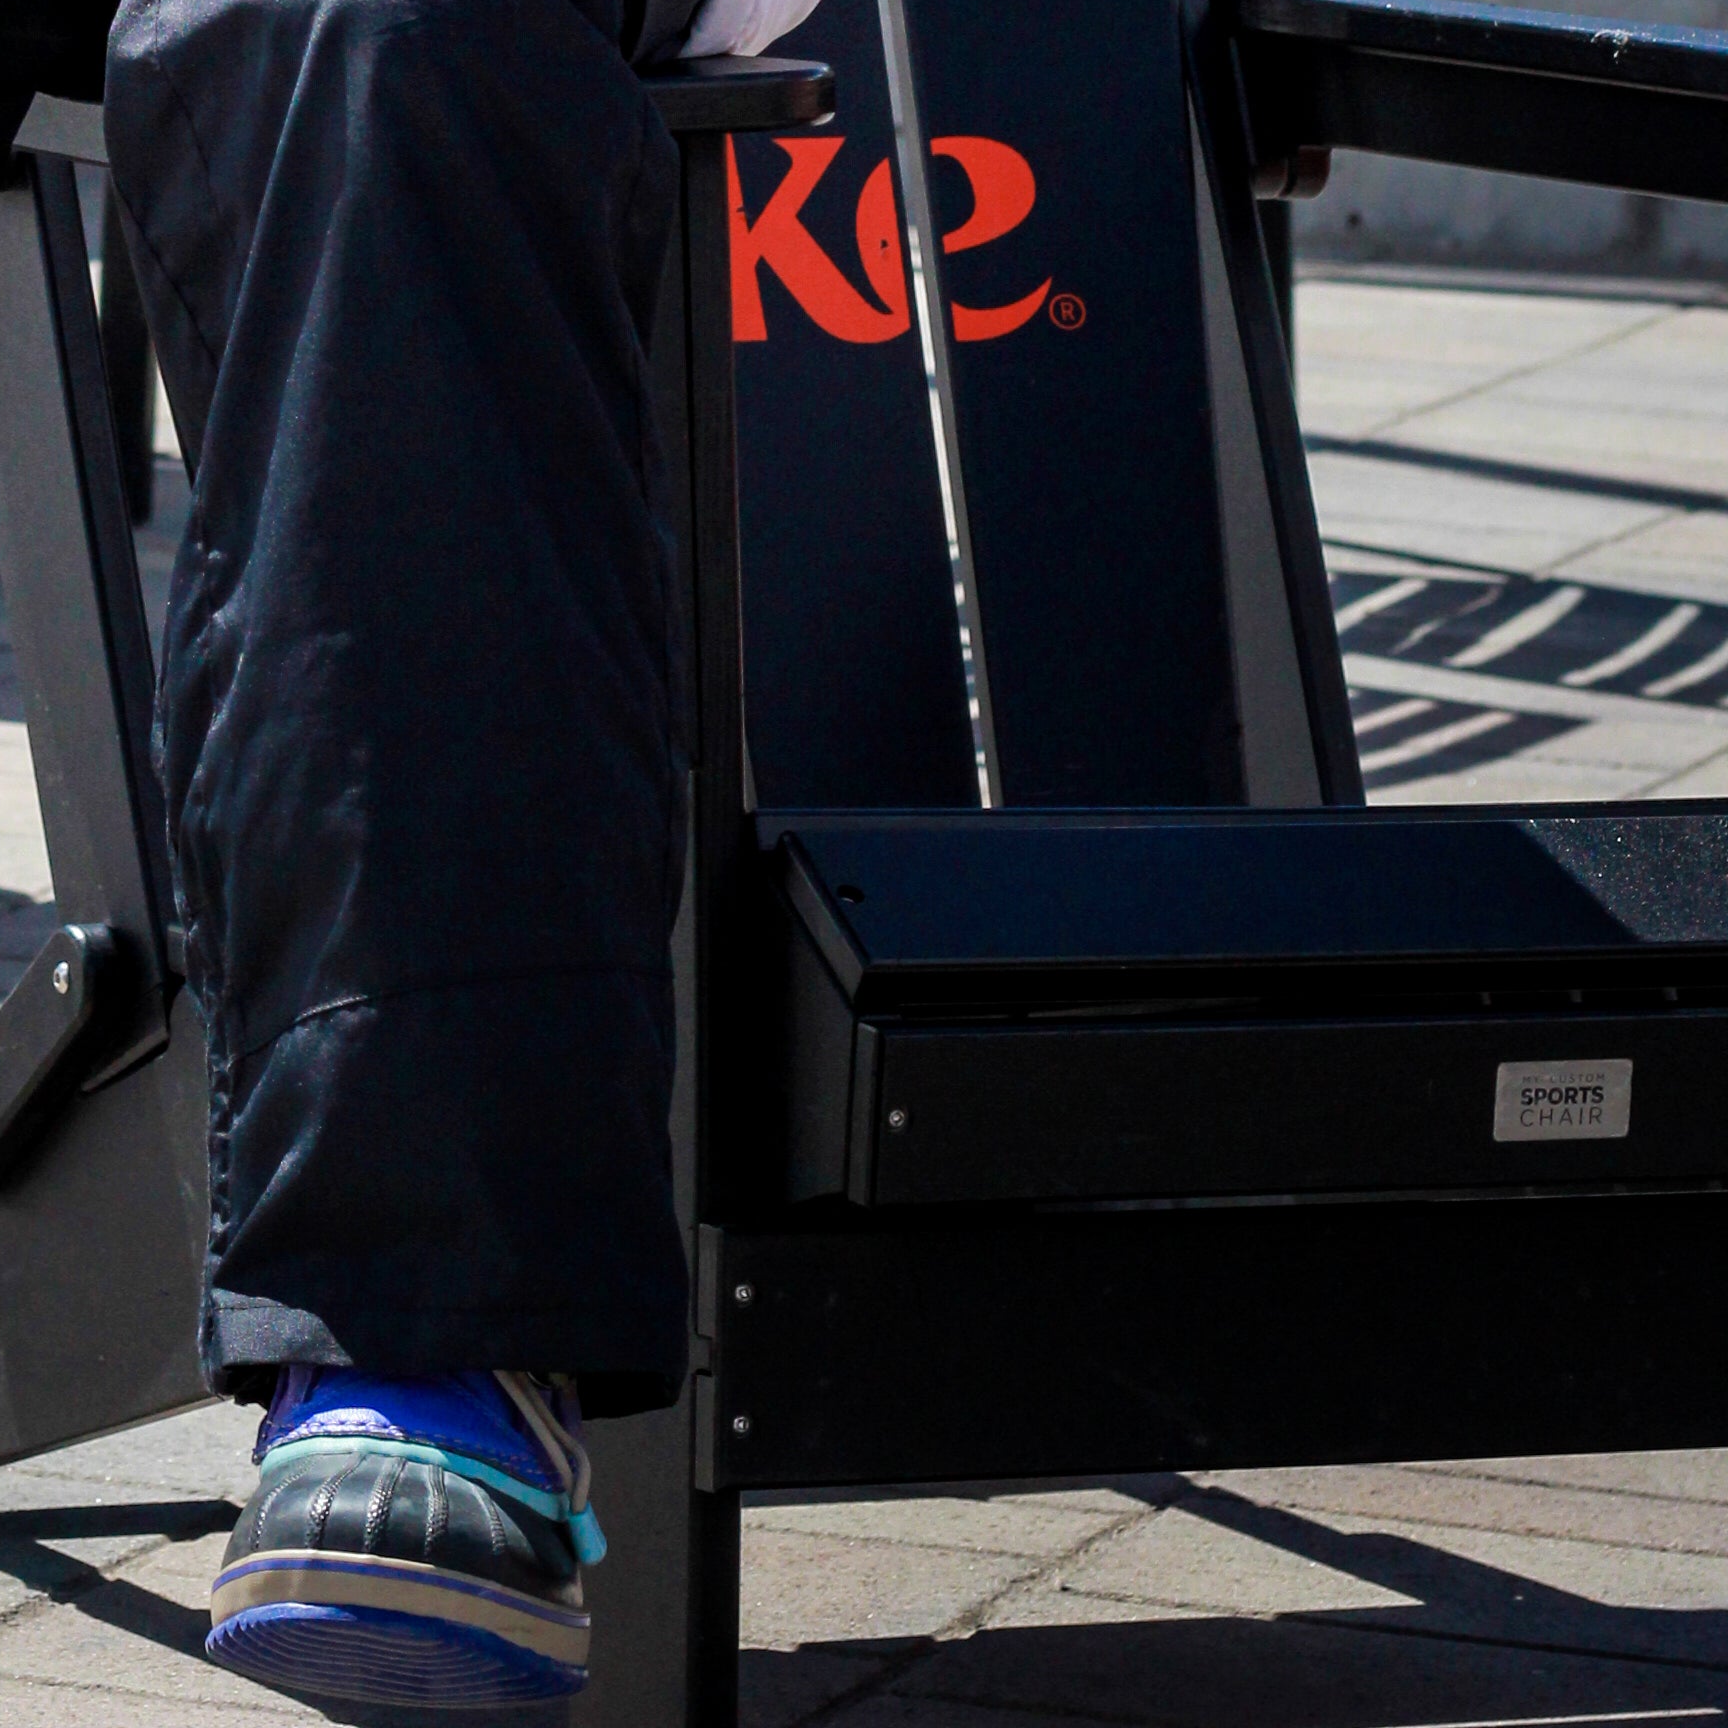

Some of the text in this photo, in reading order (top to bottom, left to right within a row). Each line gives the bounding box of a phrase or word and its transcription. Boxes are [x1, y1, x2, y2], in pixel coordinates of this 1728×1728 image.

[1550, 1073, 1606, 1083] CUSTOM
[1521, 1087, 1604, 1105] SPORTS
[1520, 1106, 1603, 1127] CHAIR
